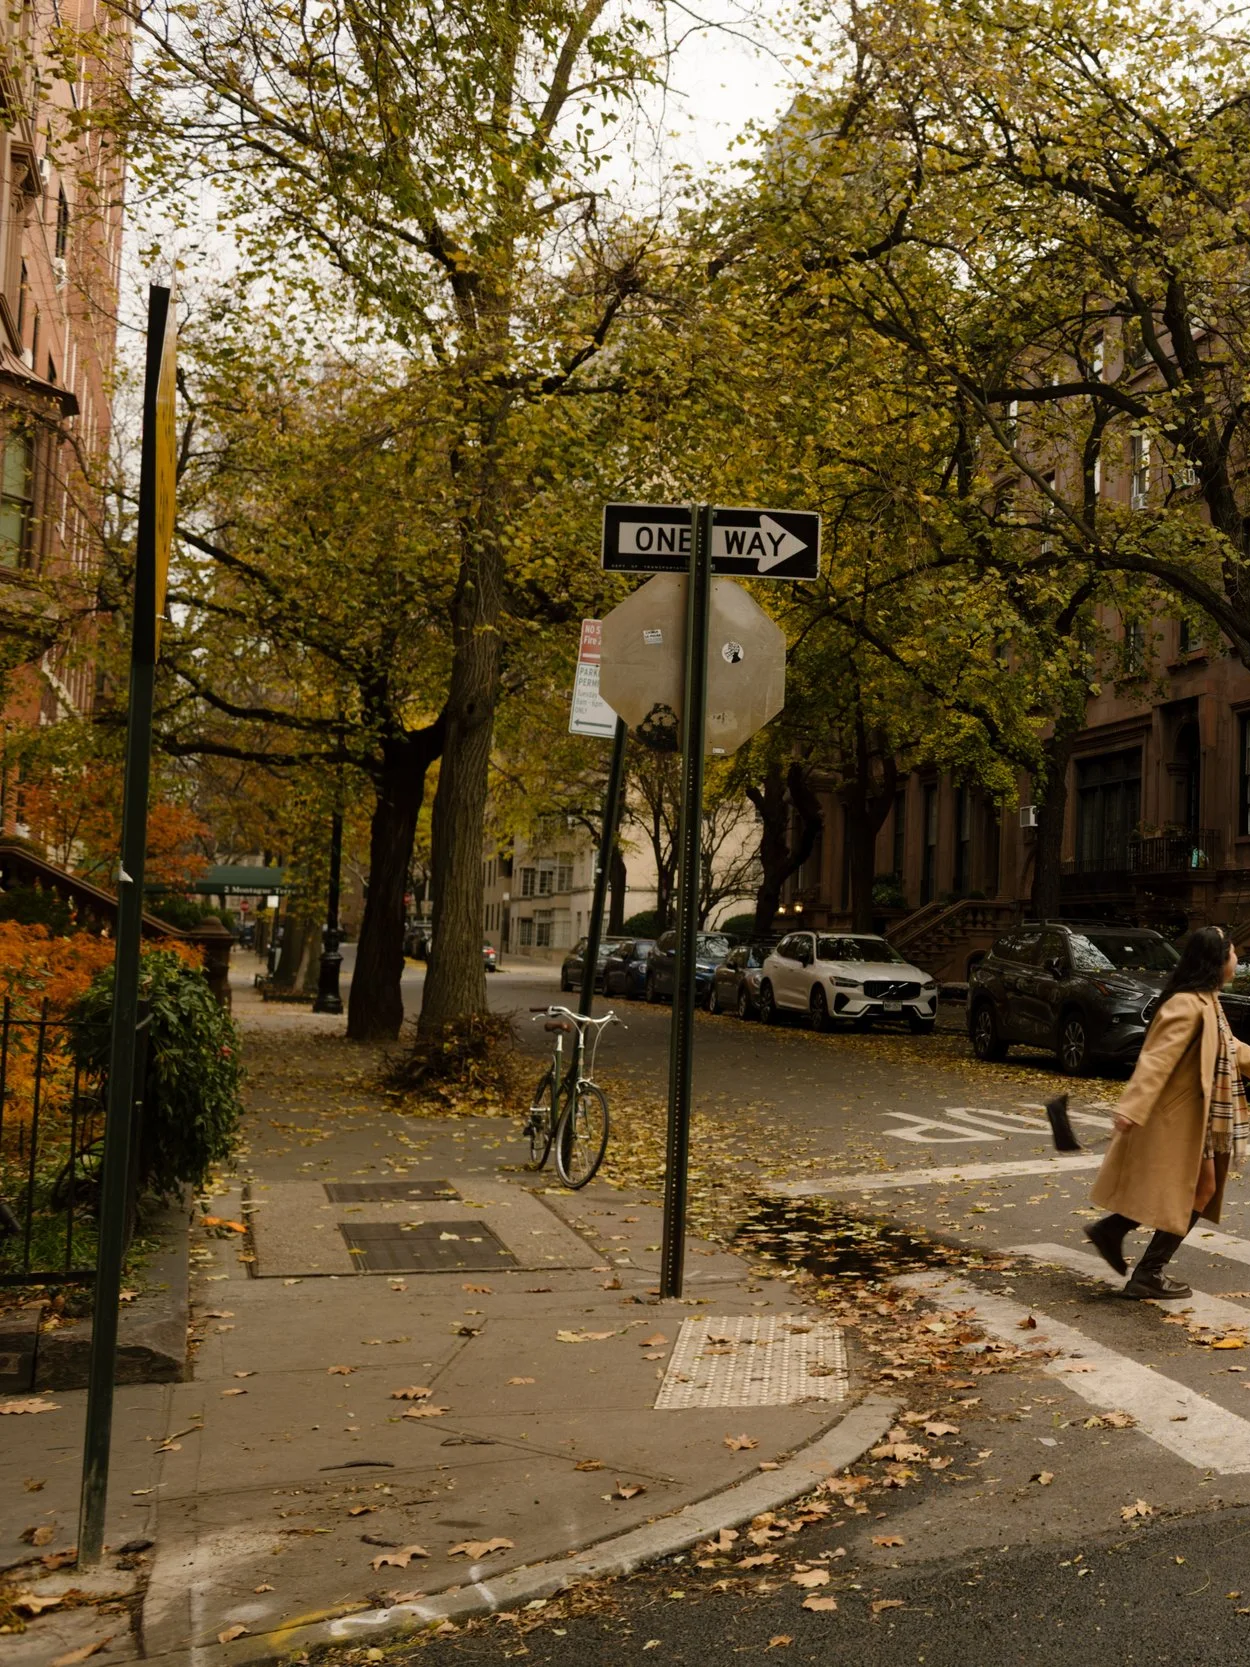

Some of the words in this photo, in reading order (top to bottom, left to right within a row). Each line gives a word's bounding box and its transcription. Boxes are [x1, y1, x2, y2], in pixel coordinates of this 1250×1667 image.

[635, 527, 691, 552] ONE
[725, 530, 786, 557] WAY
[585, 625, 594, 634] NO
[584, 636, 597, 646] Fire
[580, 667, 599, 676] PARK
[232, 886, 272, 894] Montague
